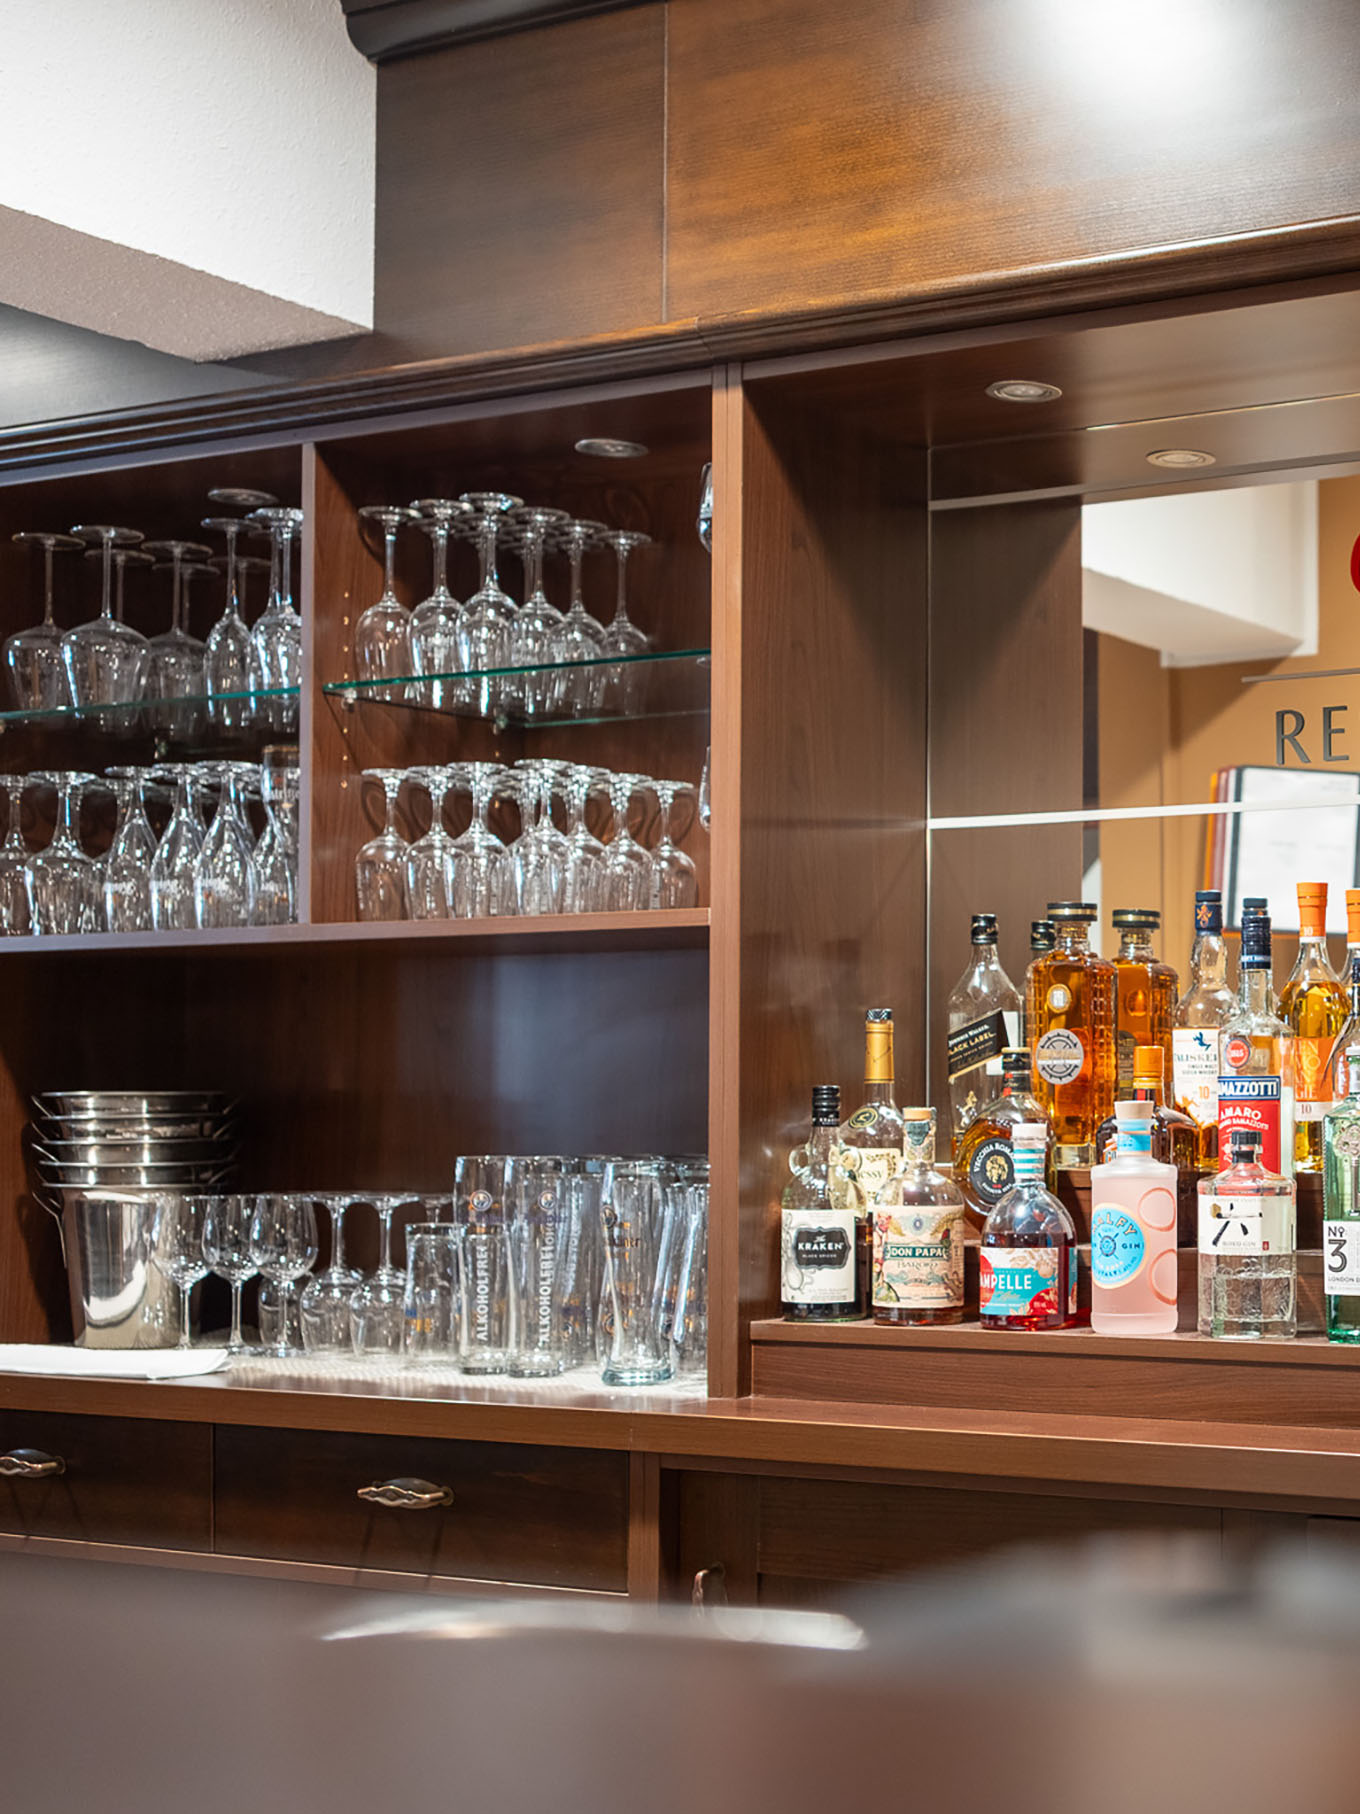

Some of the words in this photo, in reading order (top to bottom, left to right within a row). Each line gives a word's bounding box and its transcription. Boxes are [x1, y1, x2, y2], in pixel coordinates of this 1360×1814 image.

[1200, 1086, 1210, 1099] 10
[1301, 1104, 1313, 1114] 10
[798, 1242, 843, 1250] KRAKEN
[891, 1248, 912, 1257] DON
[915, 1248, 942, 1257] PAPA
[1328, 1239, 1348, 1273] 3
